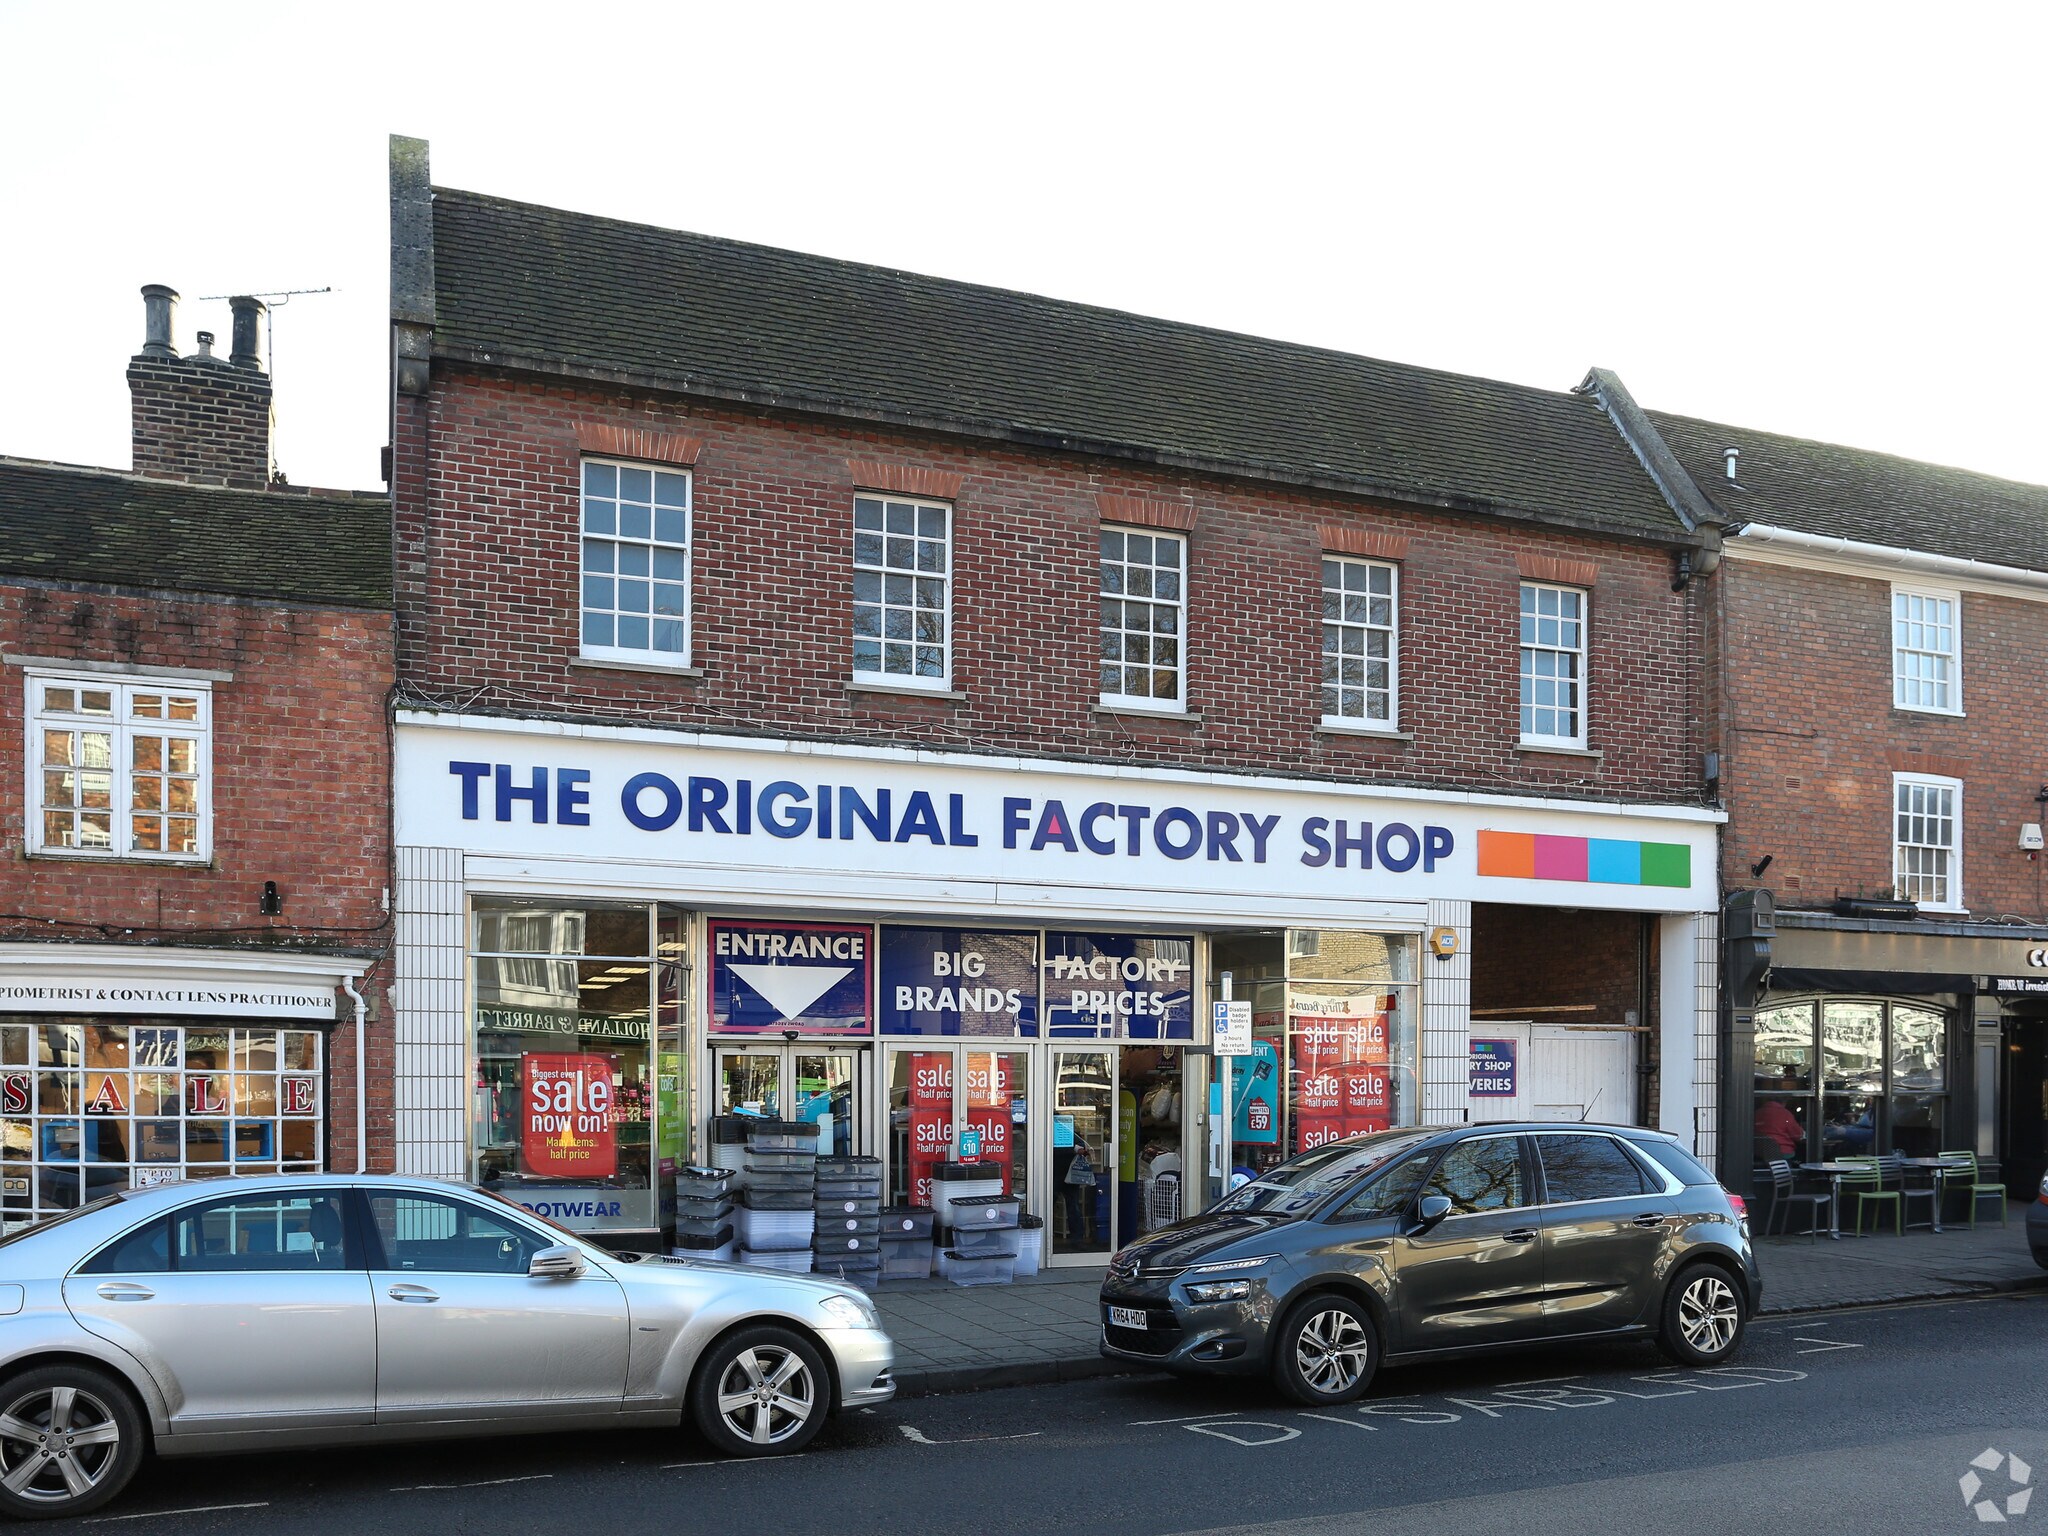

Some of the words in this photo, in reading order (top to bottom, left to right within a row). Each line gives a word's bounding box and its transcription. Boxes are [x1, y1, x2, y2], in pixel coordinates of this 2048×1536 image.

[449, 761, 590, 826] THE
[621, 772, 978, 847] ORIGINAL
[1003, 797, 1281, 863] FACTORY
[1300, 816, 1455, 874] SHOP
[716, 933, 863, 960] ENTRANCE
[1441, 937, 1454, 946] ADT
[933, 951, 986, 978] BIG
[1054, 955, 1182, 982] FACTORY
[0, 987, 93, 1000] PTOMETRIST
[96, 989, 107, 1000] &
[110, 989, 185, 1002] CONTACT
[188, 991, 227, 1003] LENS
[230, 993, 332, 1008] PRACTITIONER
[895, 986, 1022, 1014] BRANDS
[1071, 990, 1165, 1016] PRICES
[1217, 1004, 1227, 1017] P
[1304, 1020, 1338, 1043] sale
[1349, 1020, 1382, 1043] sale
[1252, 1047, 1268, 1056] ENT
[1322, 1045, 1338, 1057] price
[1367, 1044, 1382, 1056] price
[531, 1069, 558, 1079] Biggest
[560, 1071, 576, 1079] ever
[917, 1064, 952, 1087] sale
[1484, 1061, 1512, 1071] SHOP
[531, 1070, 608, 1113] sale
[1304, 1073, 1338, 1096] sale
[1349, 1072, 1383, 1095] sale
[921, 1089, 935, 1099] half
[970, 1089, 986, 1099] half
[987, 1090, 1005, 1101] pce
[1308, 1097, 1321, 1107] half
[1322, 1097, 1338, 1109] price
[1352, 1097, 1365, 1106] half
[1367, 1096, 1383, 1108] price
[531, 1115, 572, 1132] now
[578, 1113, 608, 1132] on!
[917, 1118, 952, 1141] sale
[1251, 1115, 1268, 1129] £59
[546, 1137, 567, 1150] Many
[570, 1136, 594, 1147] items
[1305, 1126, 1338, 1149] sale
[550, 1148, 567, 1159] half
[569, 1149, 590, 1161] price
[920, 1143, 934, 1153] half
[935, 1143, 948, 1155] pri
[986, 1143, 1005, 1155] price
[963, 1142, 976, 1155] £10
